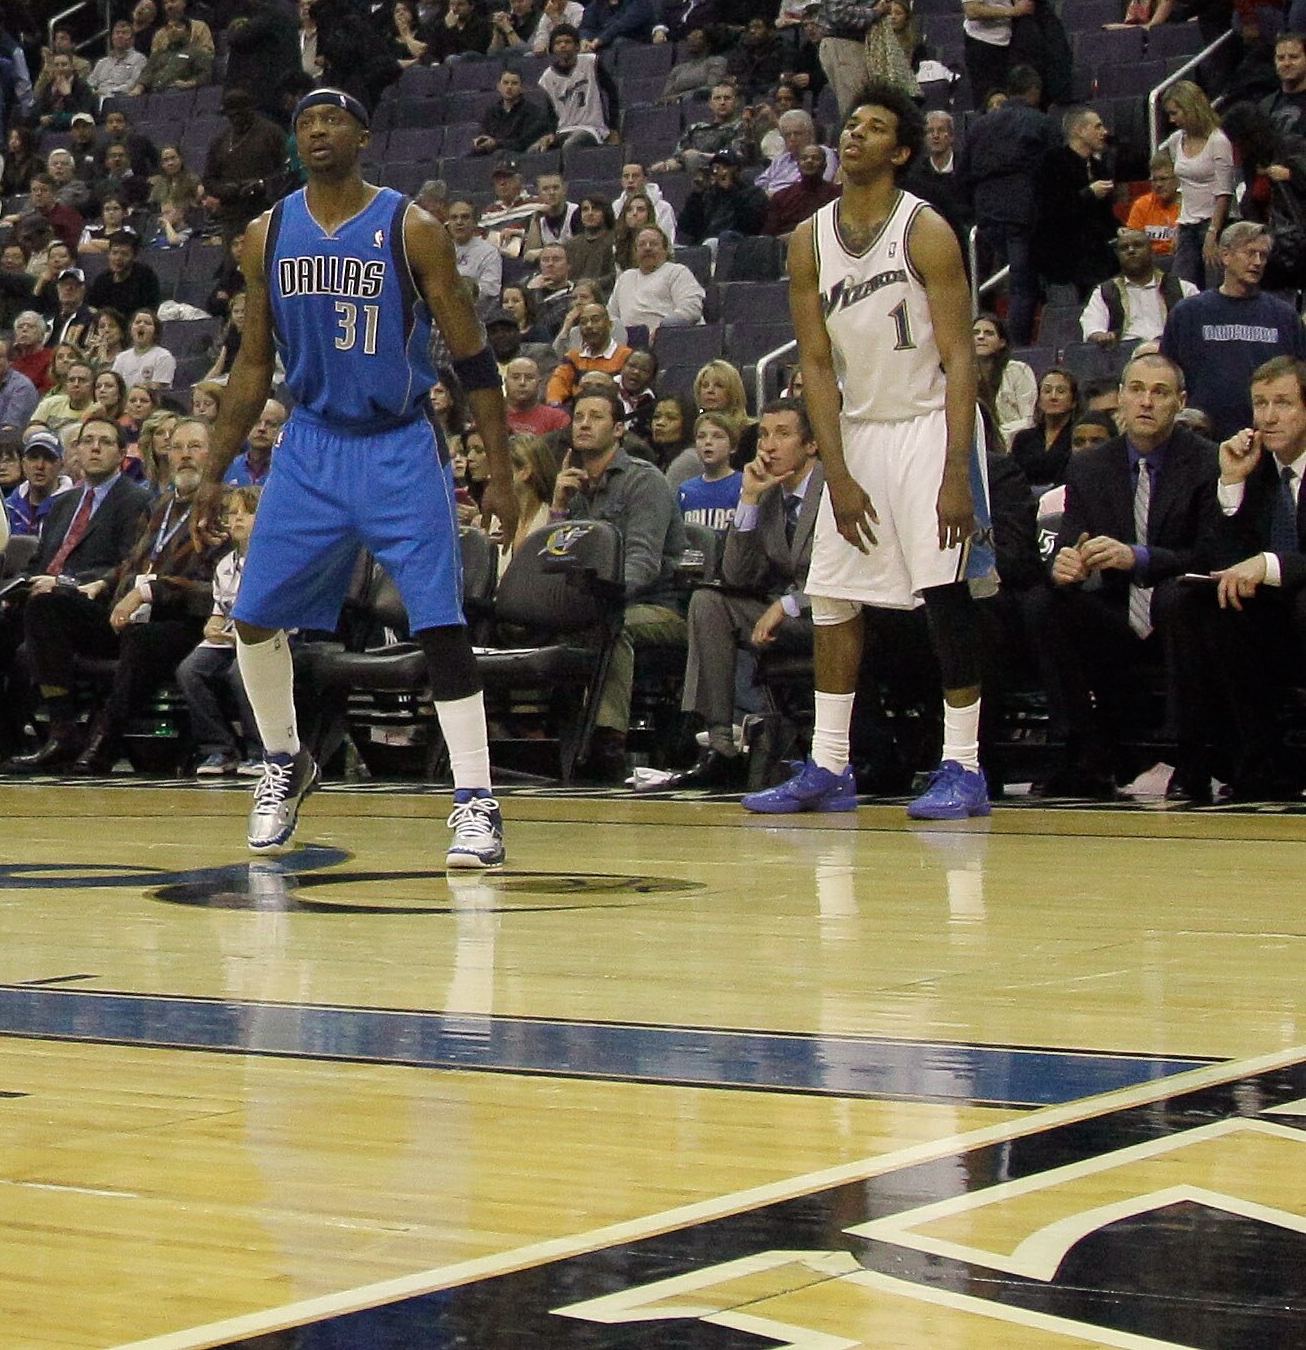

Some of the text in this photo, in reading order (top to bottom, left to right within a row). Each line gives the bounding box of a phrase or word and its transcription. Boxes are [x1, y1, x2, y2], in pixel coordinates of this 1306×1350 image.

[279, 255, 386, 299] DALLAS
[334, 301, 379, 355] 31
[888, 298, 917, 351] 1
